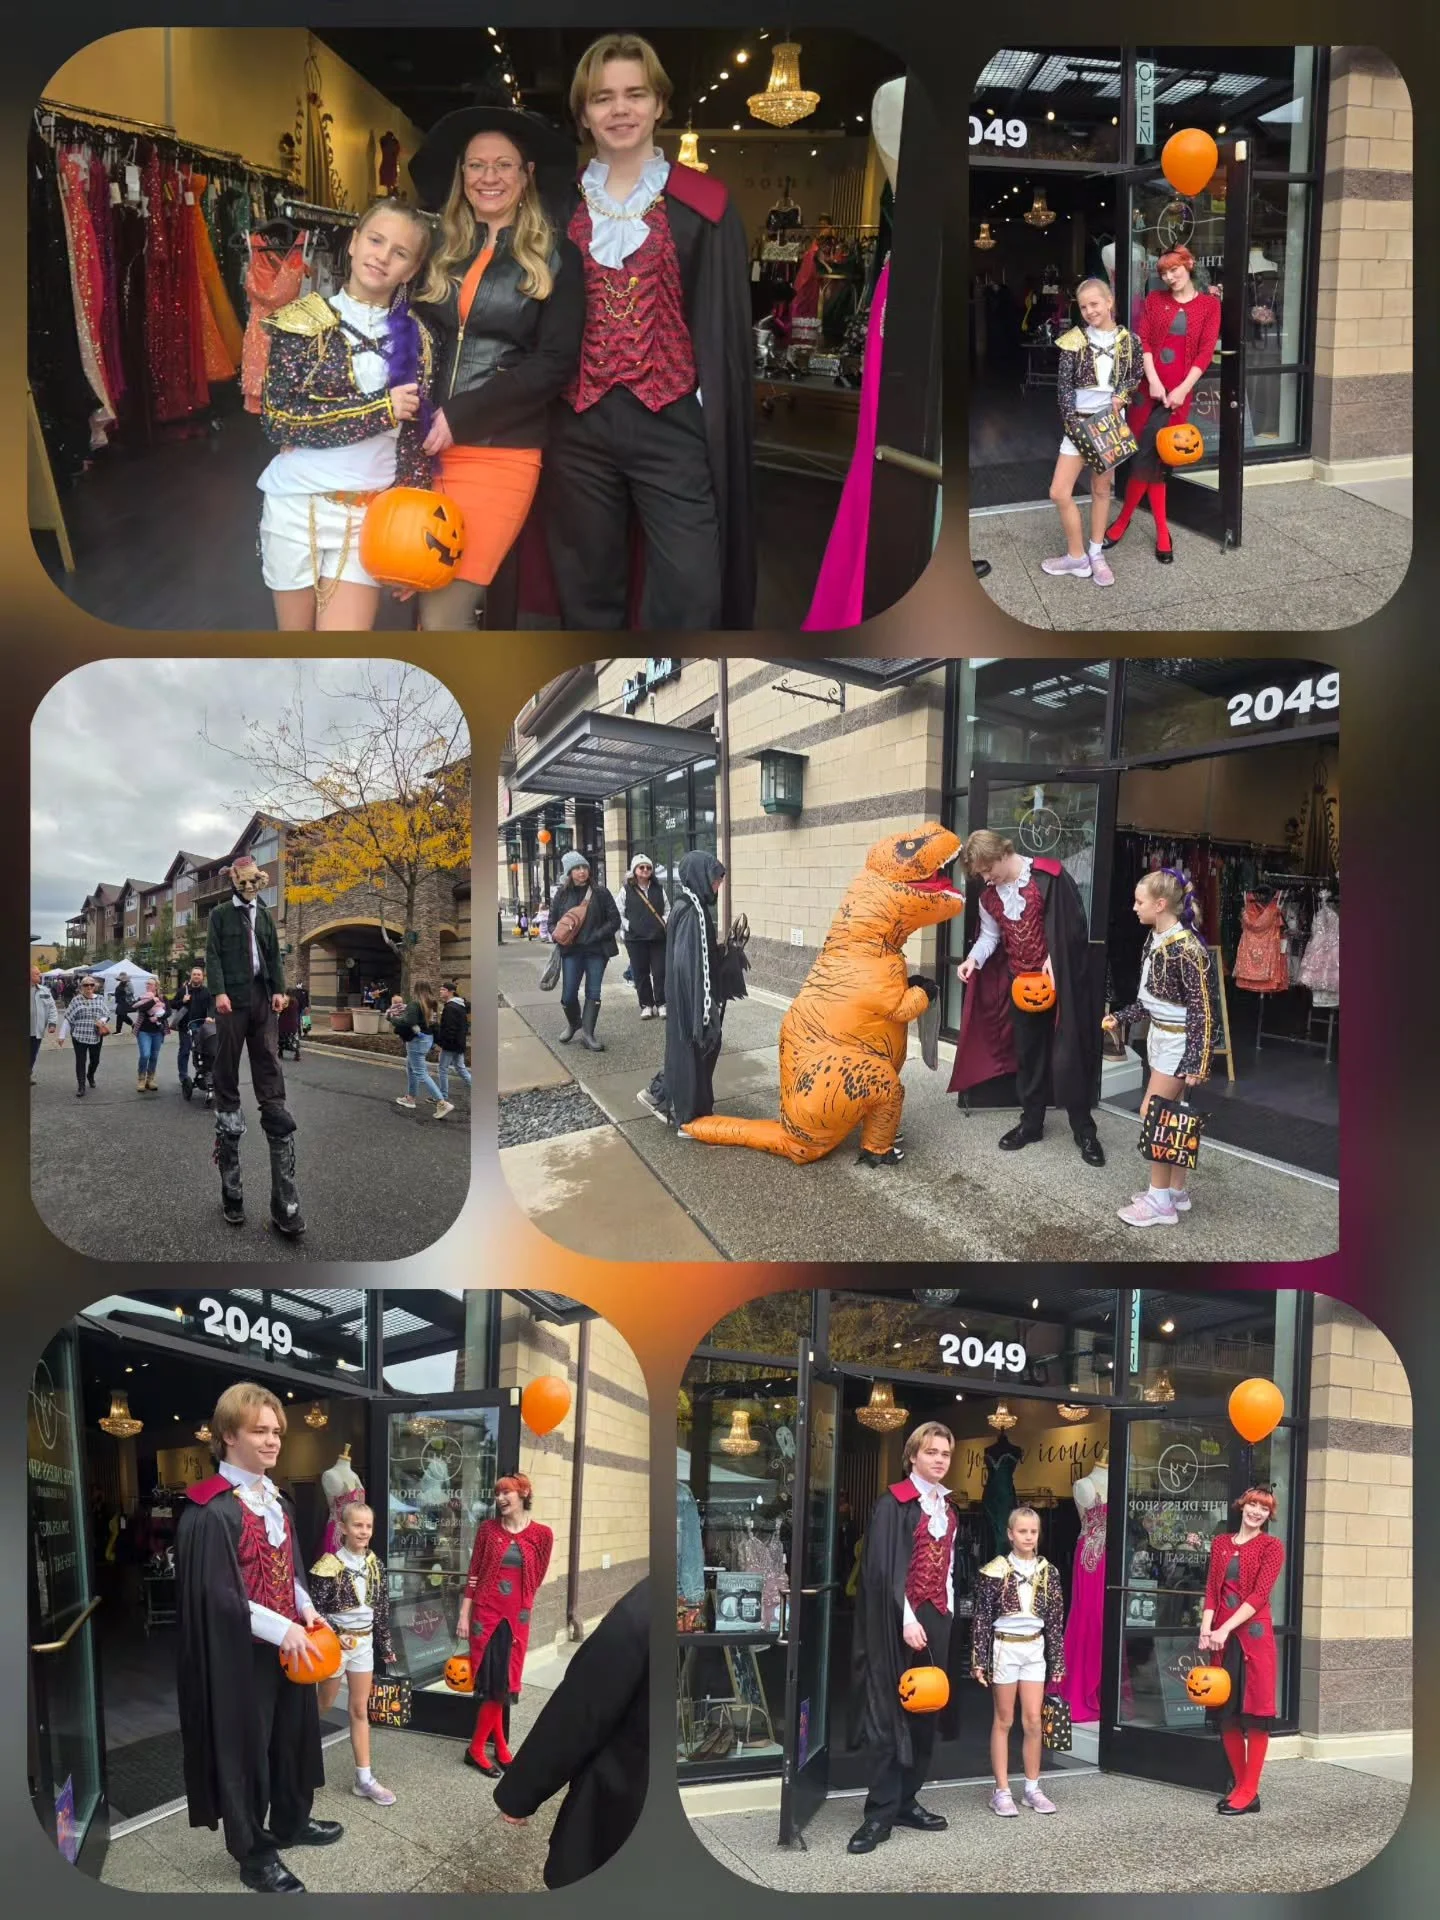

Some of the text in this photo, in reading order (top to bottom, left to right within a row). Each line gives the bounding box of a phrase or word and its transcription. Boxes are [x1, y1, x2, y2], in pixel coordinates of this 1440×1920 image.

[1138, 64, 1152, 142] OPEN
[1227, 672, 1339, 727] 2049
[1158, 1109, 1197, 1134] HAPP
[199, 1297, 292, 1355] 2049
[939, 1333, 1027, 1373] 2049
